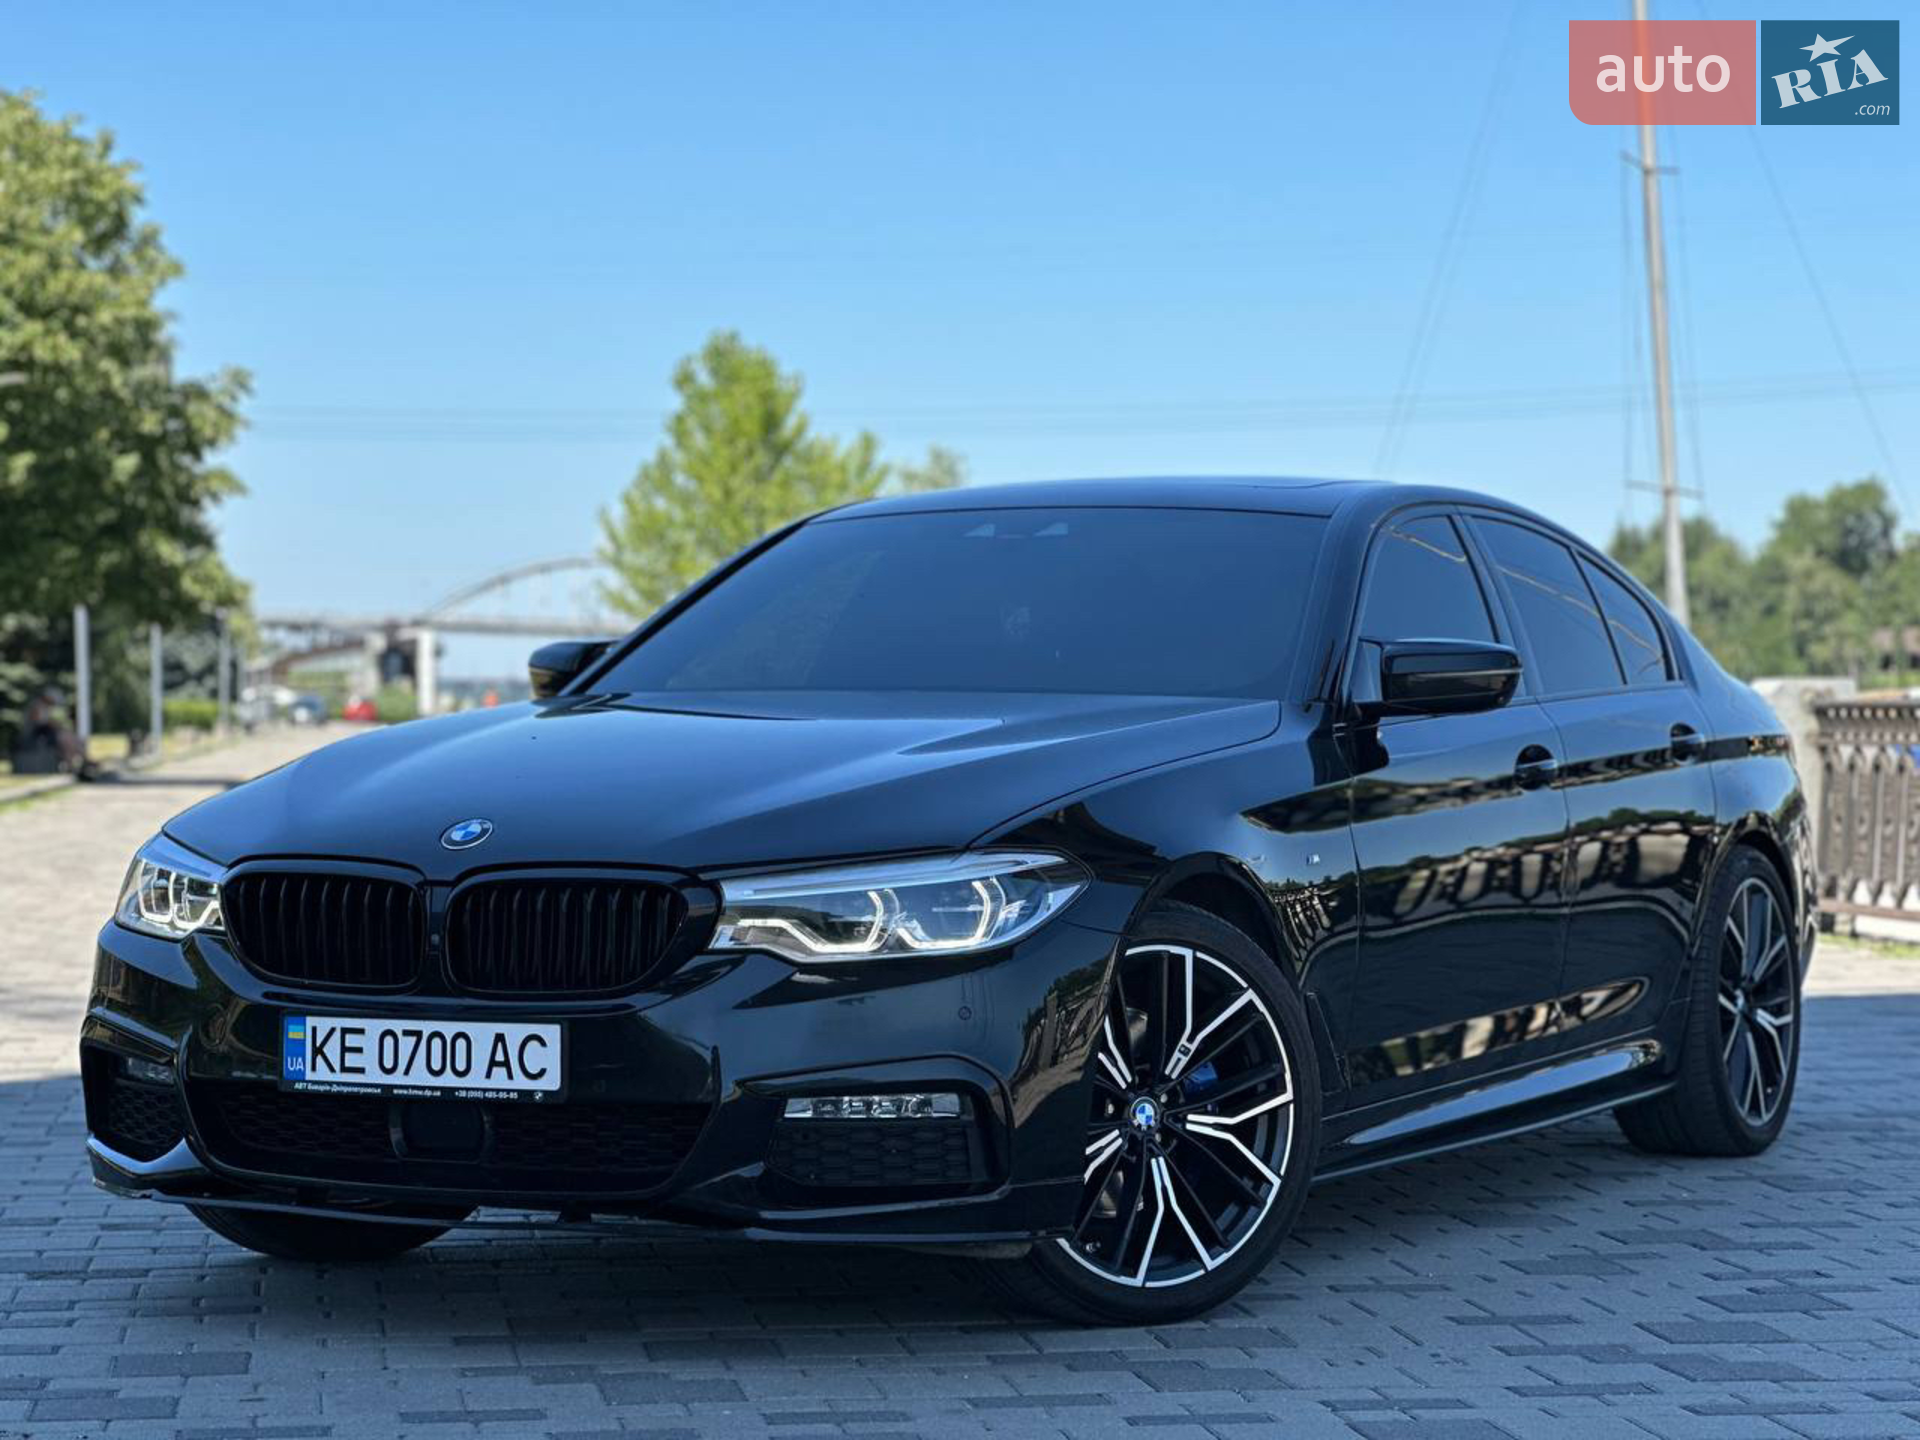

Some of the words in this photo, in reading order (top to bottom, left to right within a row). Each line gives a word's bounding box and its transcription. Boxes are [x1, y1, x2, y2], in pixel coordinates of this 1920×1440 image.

[287, 1056, 304, 1071] UA
[310, 1025, 366, 1075] KE
[378, 1028, 472, 1078] 0700
[484, 1032, 548, 1081] AC
